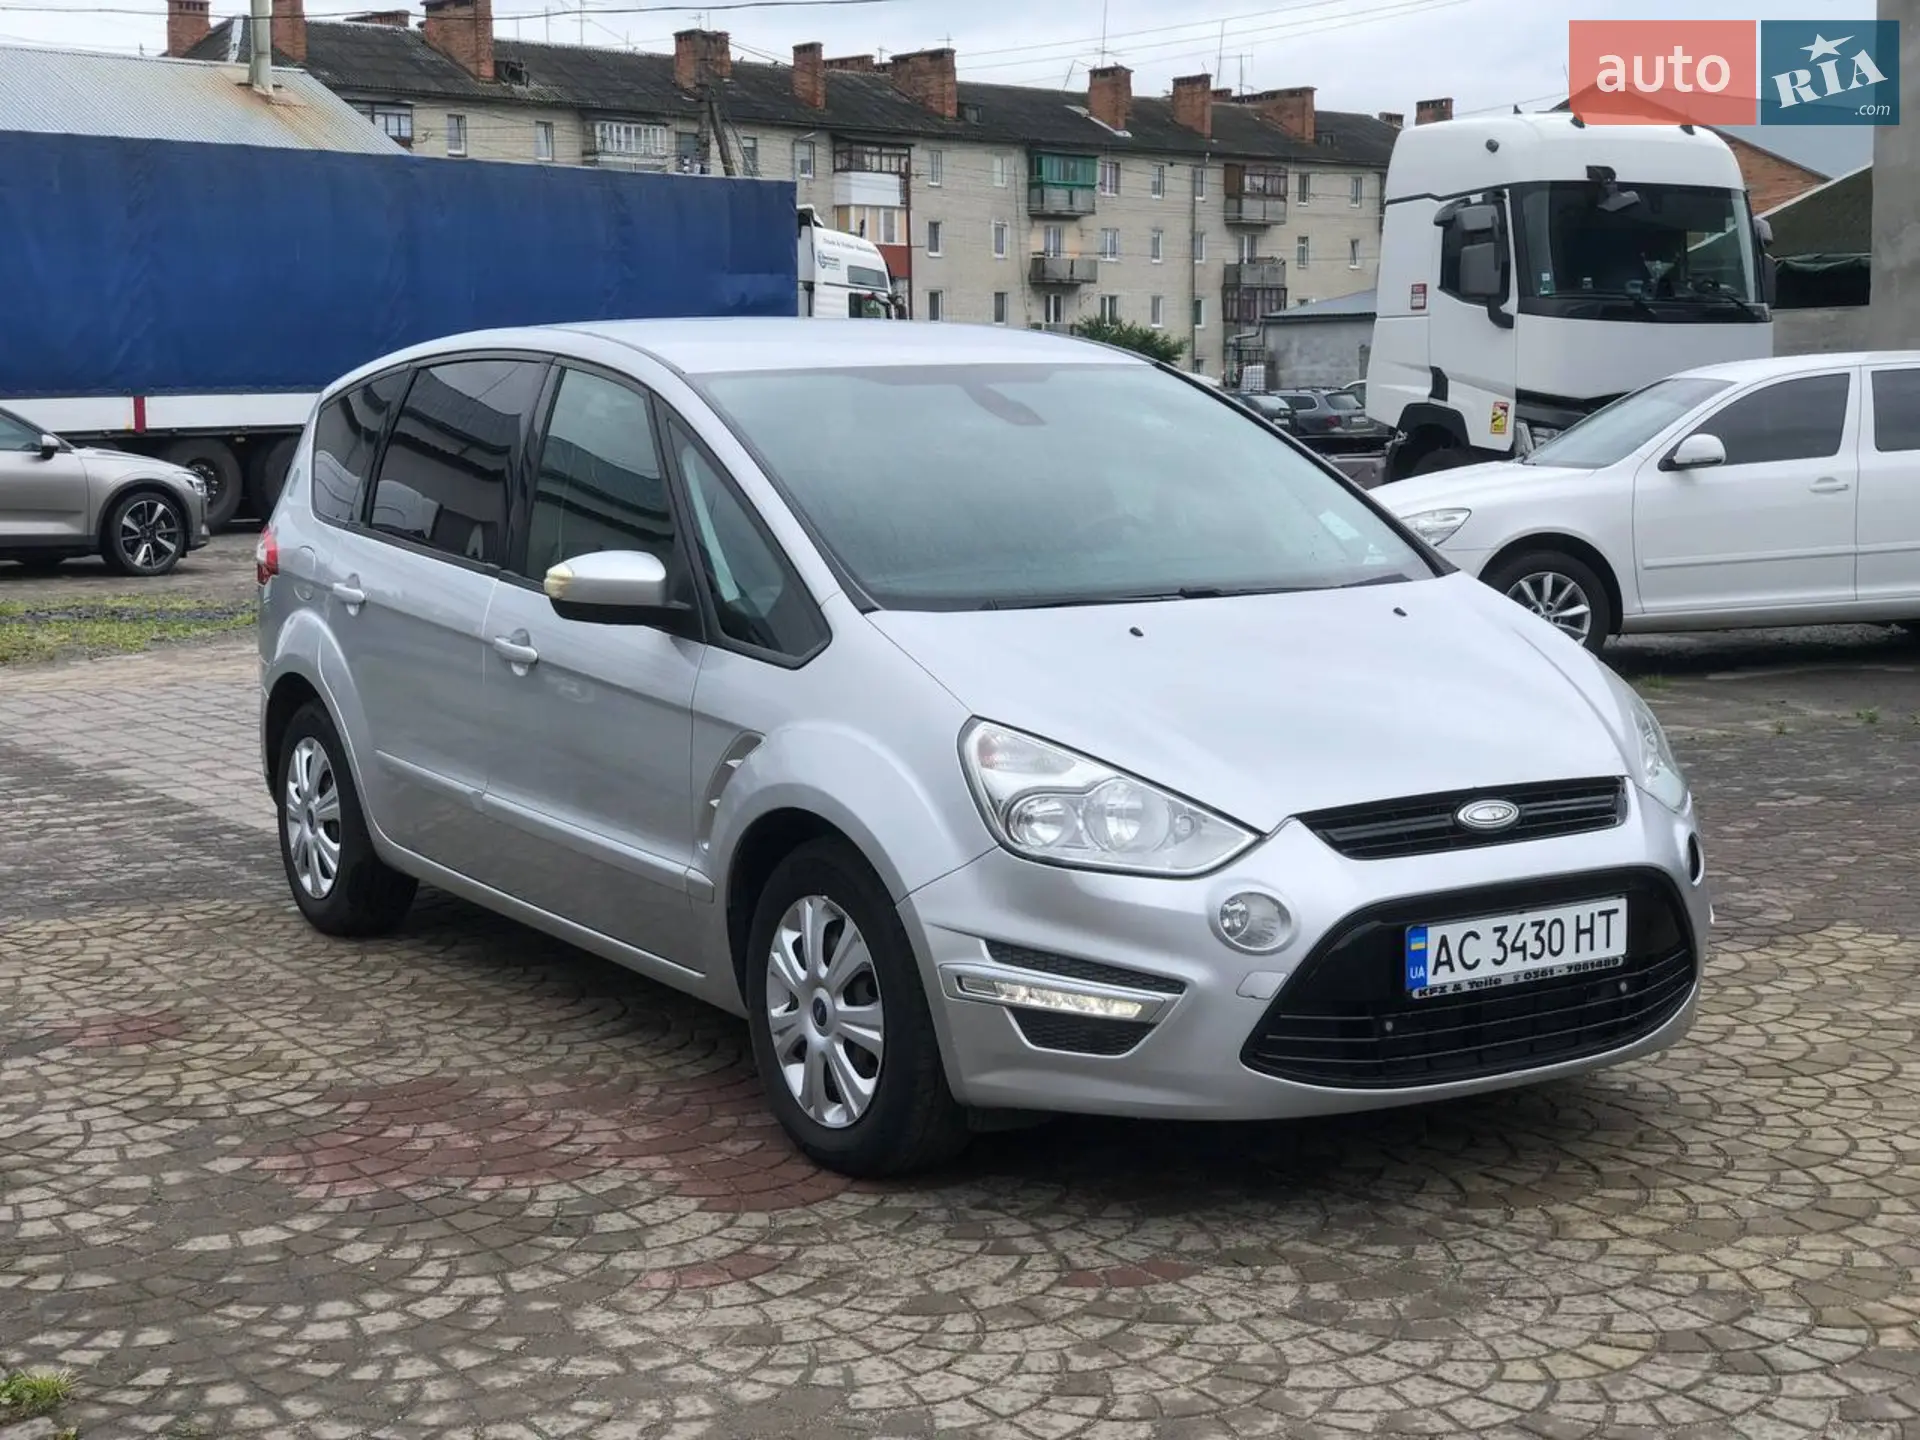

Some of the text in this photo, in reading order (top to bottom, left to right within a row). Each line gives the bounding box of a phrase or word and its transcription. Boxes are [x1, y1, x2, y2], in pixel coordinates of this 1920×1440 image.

[1432, 908, 1619, 976] AC 3430 HT
[1409, 965, 1425, 980] UA
